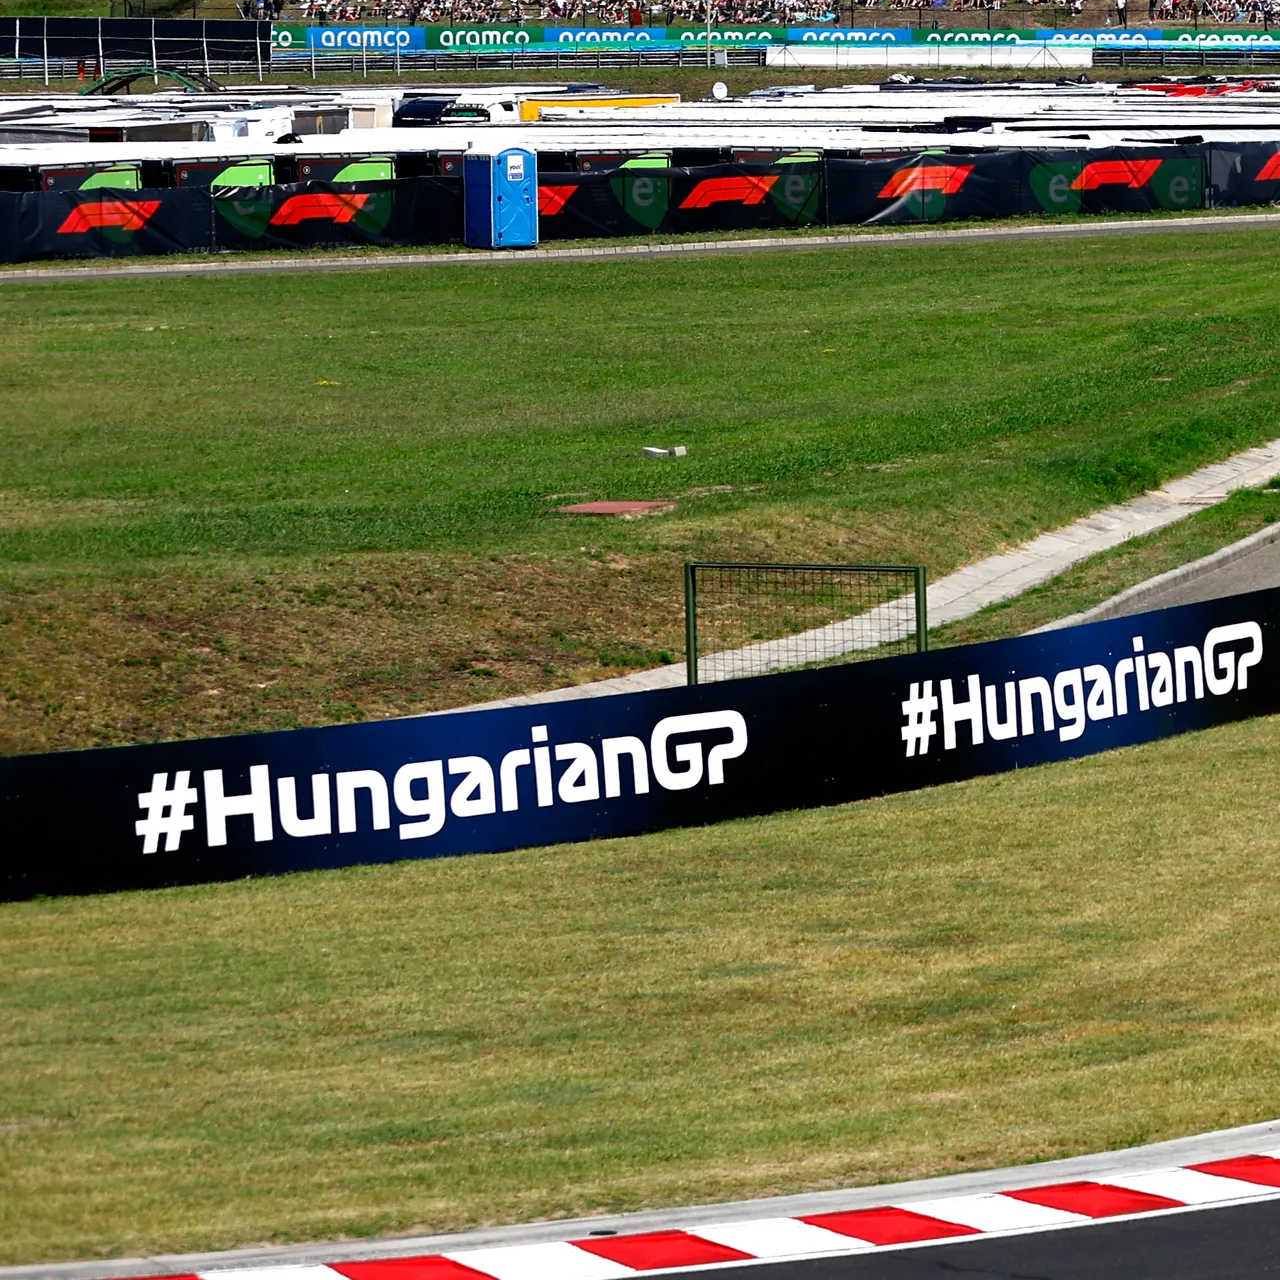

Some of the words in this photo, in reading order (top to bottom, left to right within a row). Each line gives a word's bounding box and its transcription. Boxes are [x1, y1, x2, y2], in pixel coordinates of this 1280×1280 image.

[321, 30, 410, 47] aramco
[440, 30, 530, 46] aramco
[901, 621, 1263, 757] #HungarianGP
[135, 709, 748, 854] #HungarianGP
